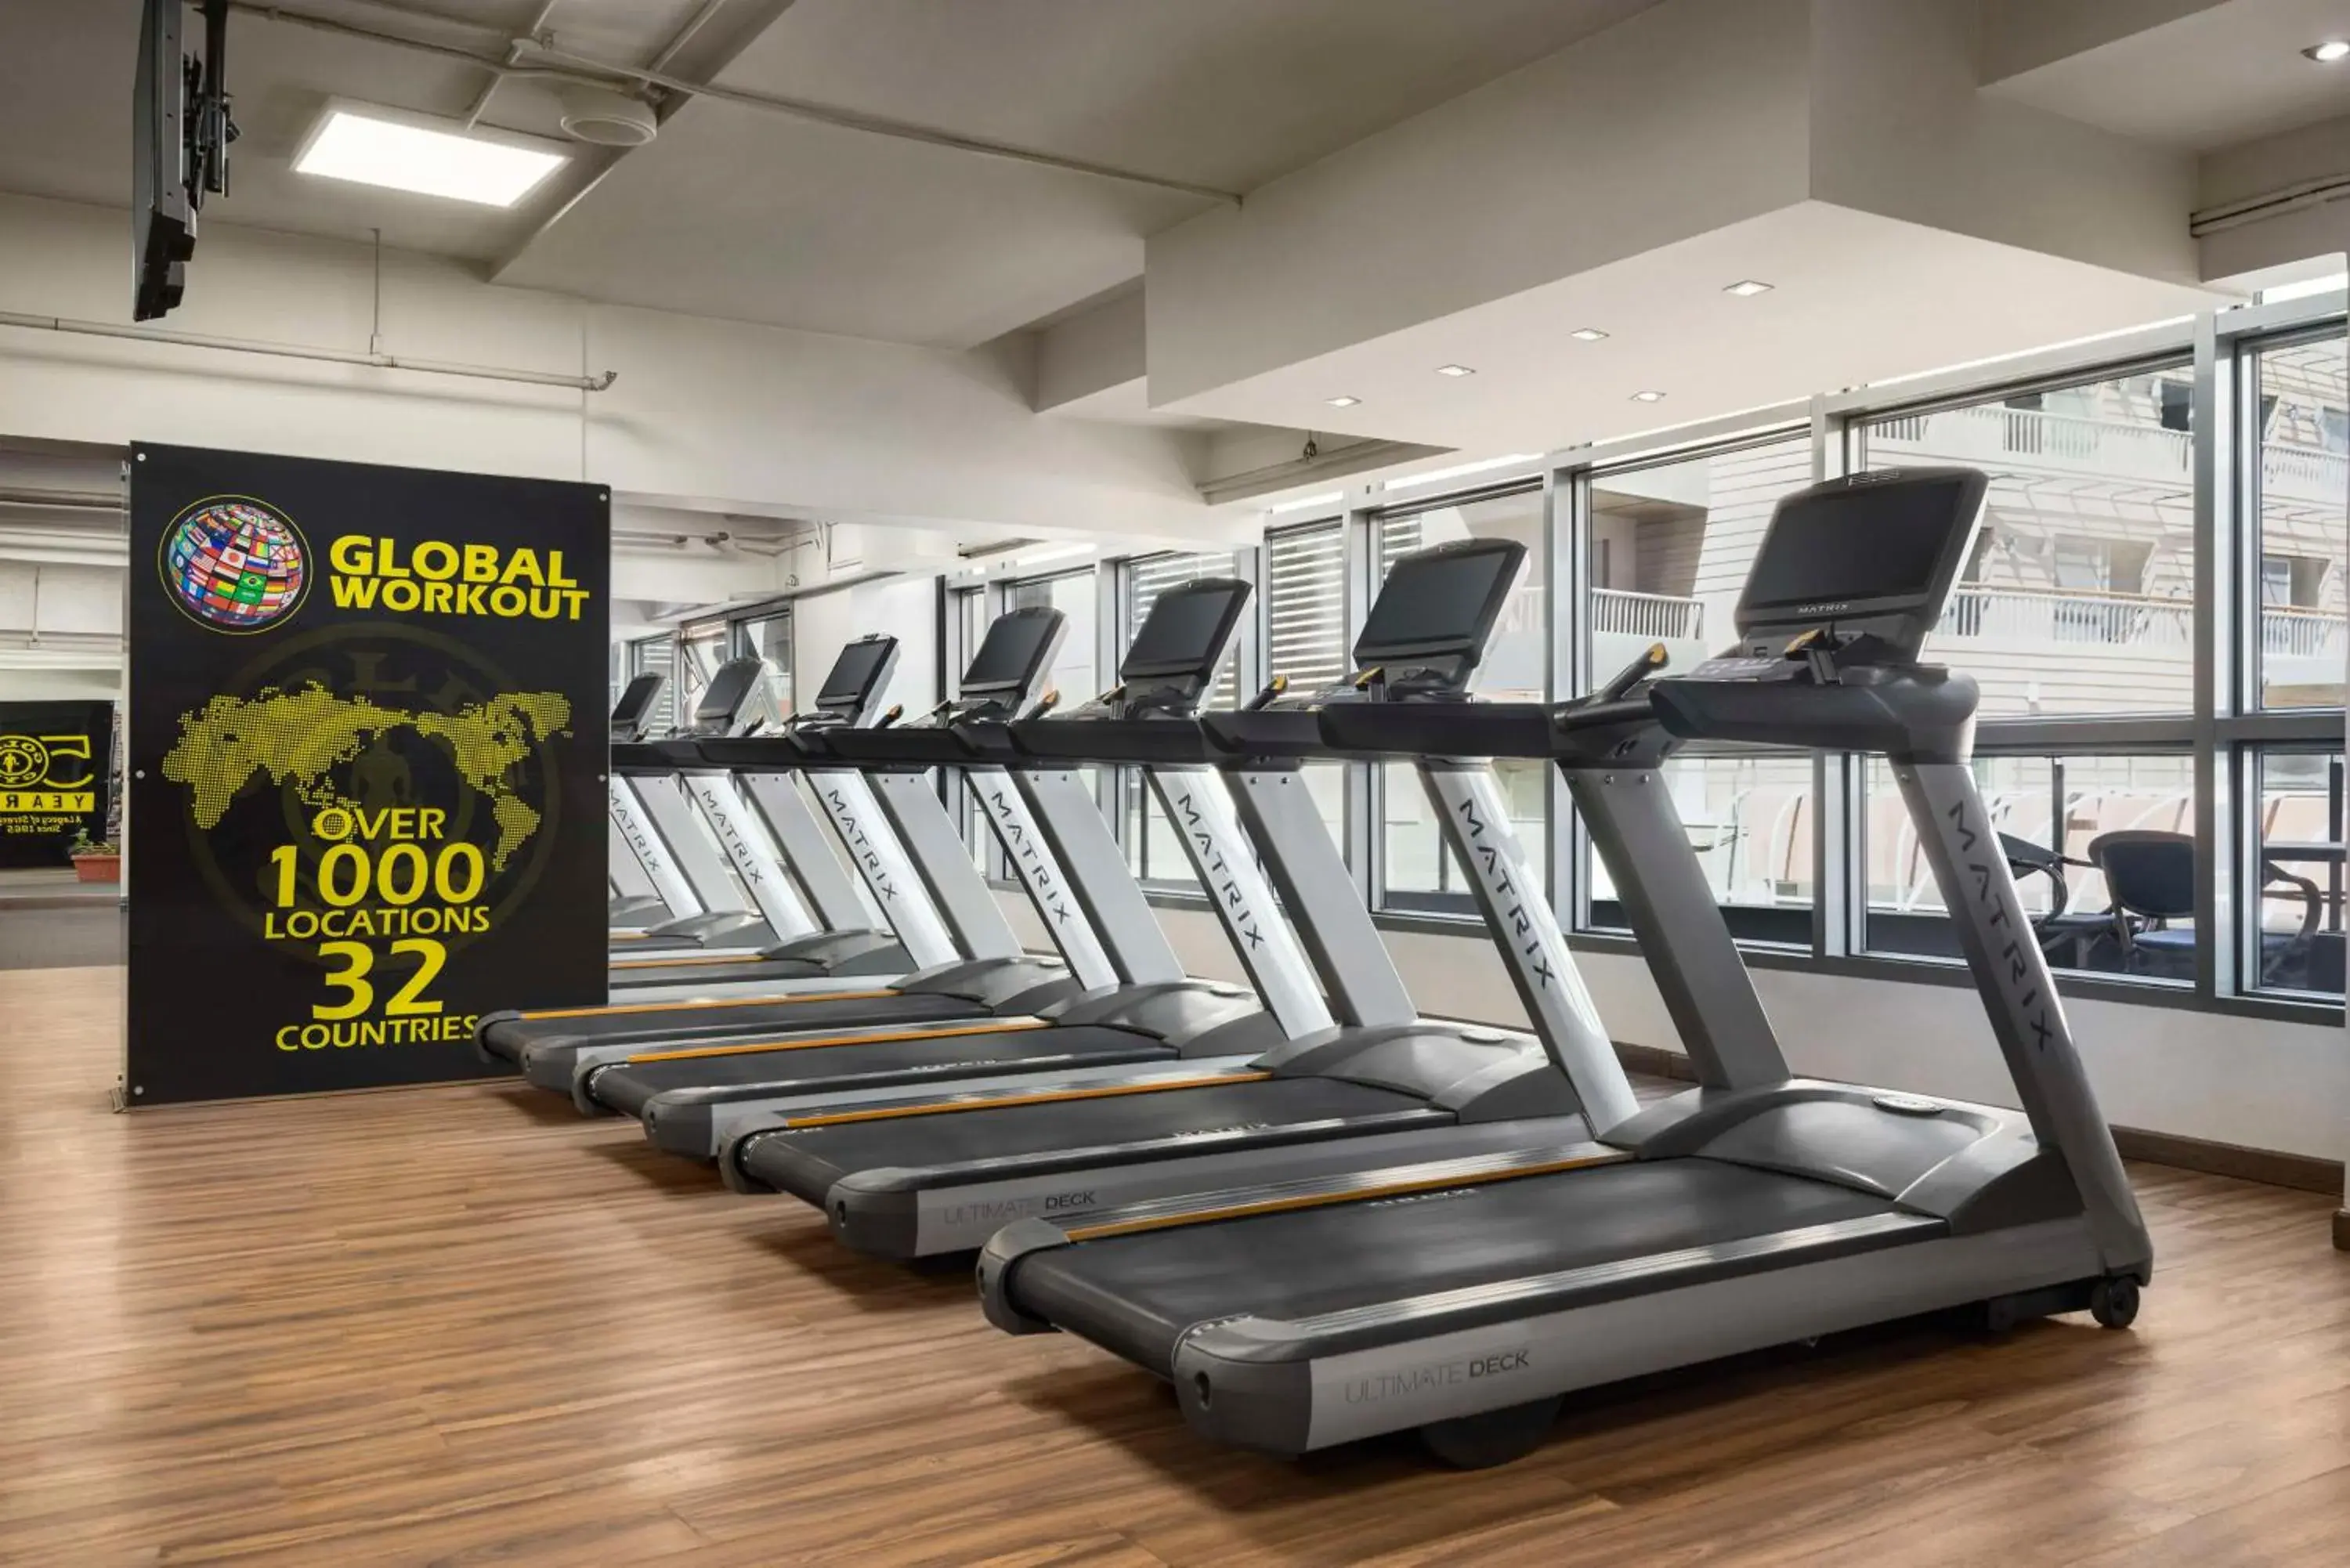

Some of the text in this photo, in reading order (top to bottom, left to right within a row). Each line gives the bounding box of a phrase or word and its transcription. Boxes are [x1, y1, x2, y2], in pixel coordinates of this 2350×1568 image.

[330, 535, 578, 588] GLOBAL
[330, 575, 590, 620] WORKOUT
[1798, 603, 1849, 614] MATRIX
[313, 806, 446, 840] OVER
[703, 789, 763, 884] MATRIX
[827, 789, 900, 903] MATRIX
[272, 842, 485, 908] 1000
[991, 791, 1072, 925] MATRIX
[1177, 793, 1266, 950] MATRIX
[265, 905, 490, 940] LOCATIONS
[1458, 797, 1556, 991] MATRIX
[1947, 799, 2055, 1053] MATRIX
[313, 938, 447, 1021] 32
[275, 1014, 479, 1051] COUNTRIES
[1045, 1190, 1096, 1211] DECK
[1344, 1349, 1531, 1404] ULTIMATE DECK
